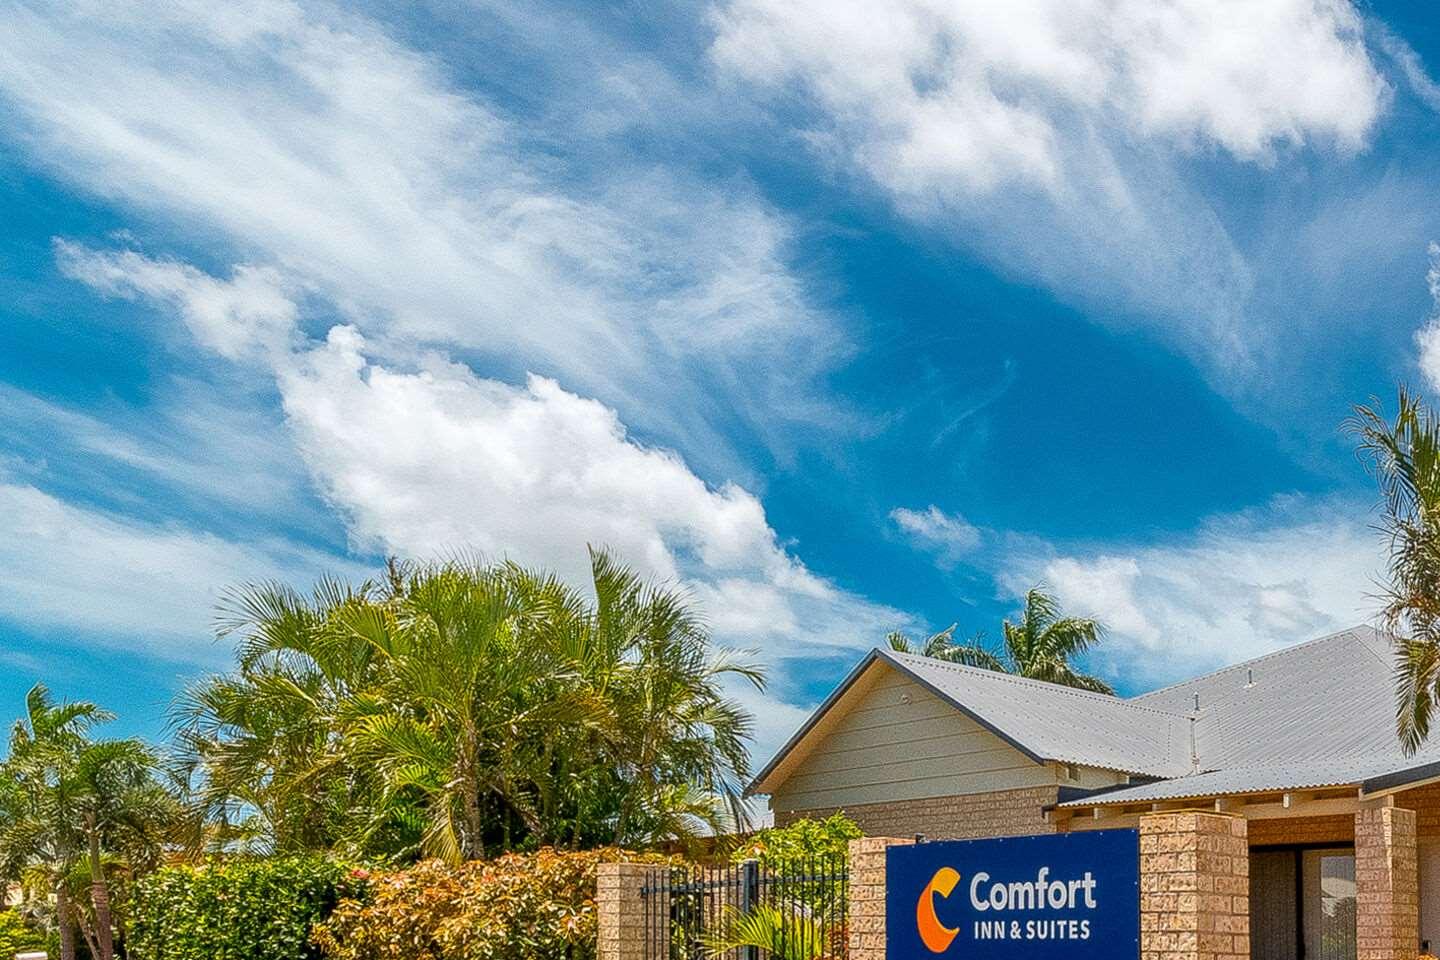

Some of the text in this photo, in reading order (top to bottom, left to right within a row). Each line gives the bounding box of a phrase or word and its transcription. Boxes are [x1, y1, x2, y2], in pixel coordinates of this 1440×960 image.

[969, 867, 1097, 911] Comfort
[974, 920, 1090, 940] INN & SUITES
